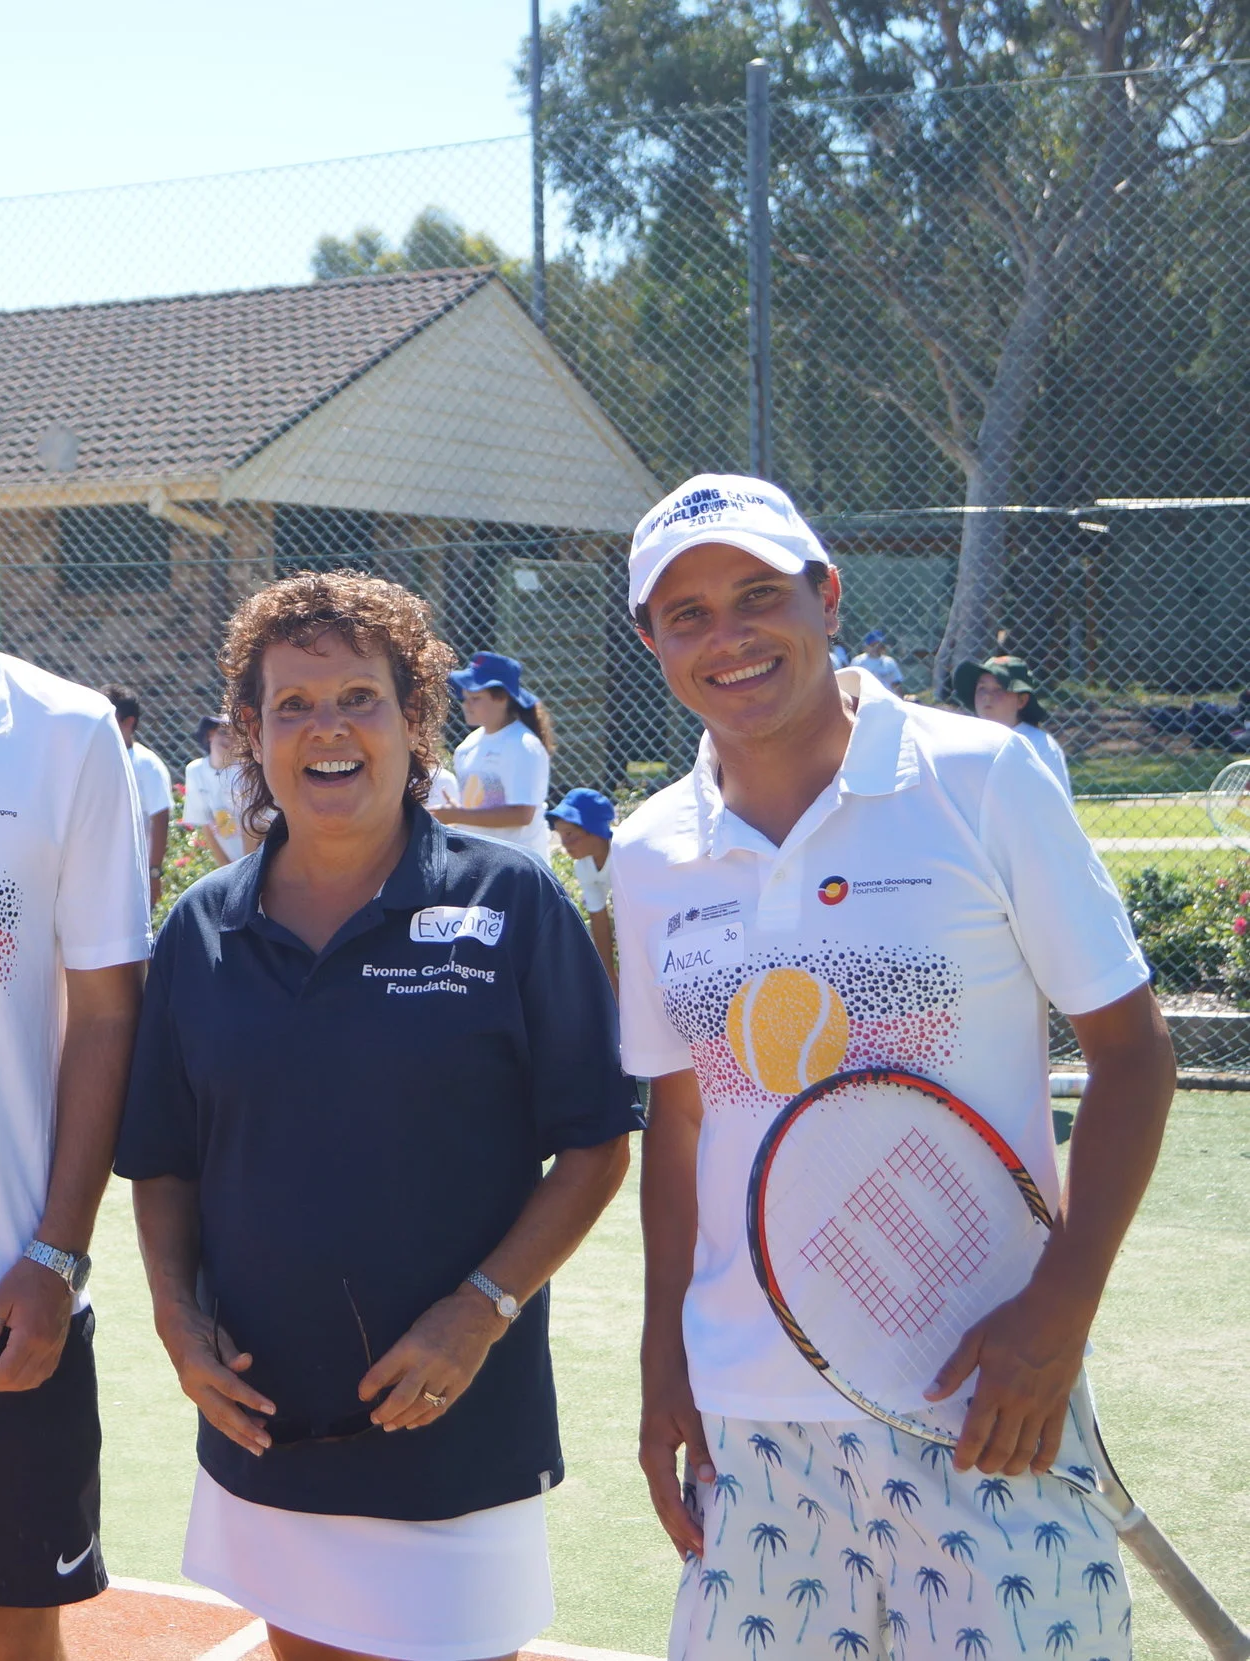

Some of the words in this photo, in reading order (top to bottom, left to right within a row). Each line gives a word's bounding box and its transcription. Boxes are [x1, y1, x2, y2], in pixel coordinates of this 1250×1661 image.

[663, 499, 746, 530] MELBOURNE
[688, 513, 723, 528] 2017
[852, 880, 882, 888] Evonne
[884, 876, 933, 886] Goolagong
[852, 886, 899, 895] Foundation
[418, 911, 500, 938] Evonne
[724, 928, 738, 942] 30
[662, 949, 713, 974] ANZAC
[362, 964, 417, 977] Evonne
[421, 961, 496, 983] Goolagong
[386, 979, 468, 994] Foundation
[850, 1388, 913, 1431] ROGER
